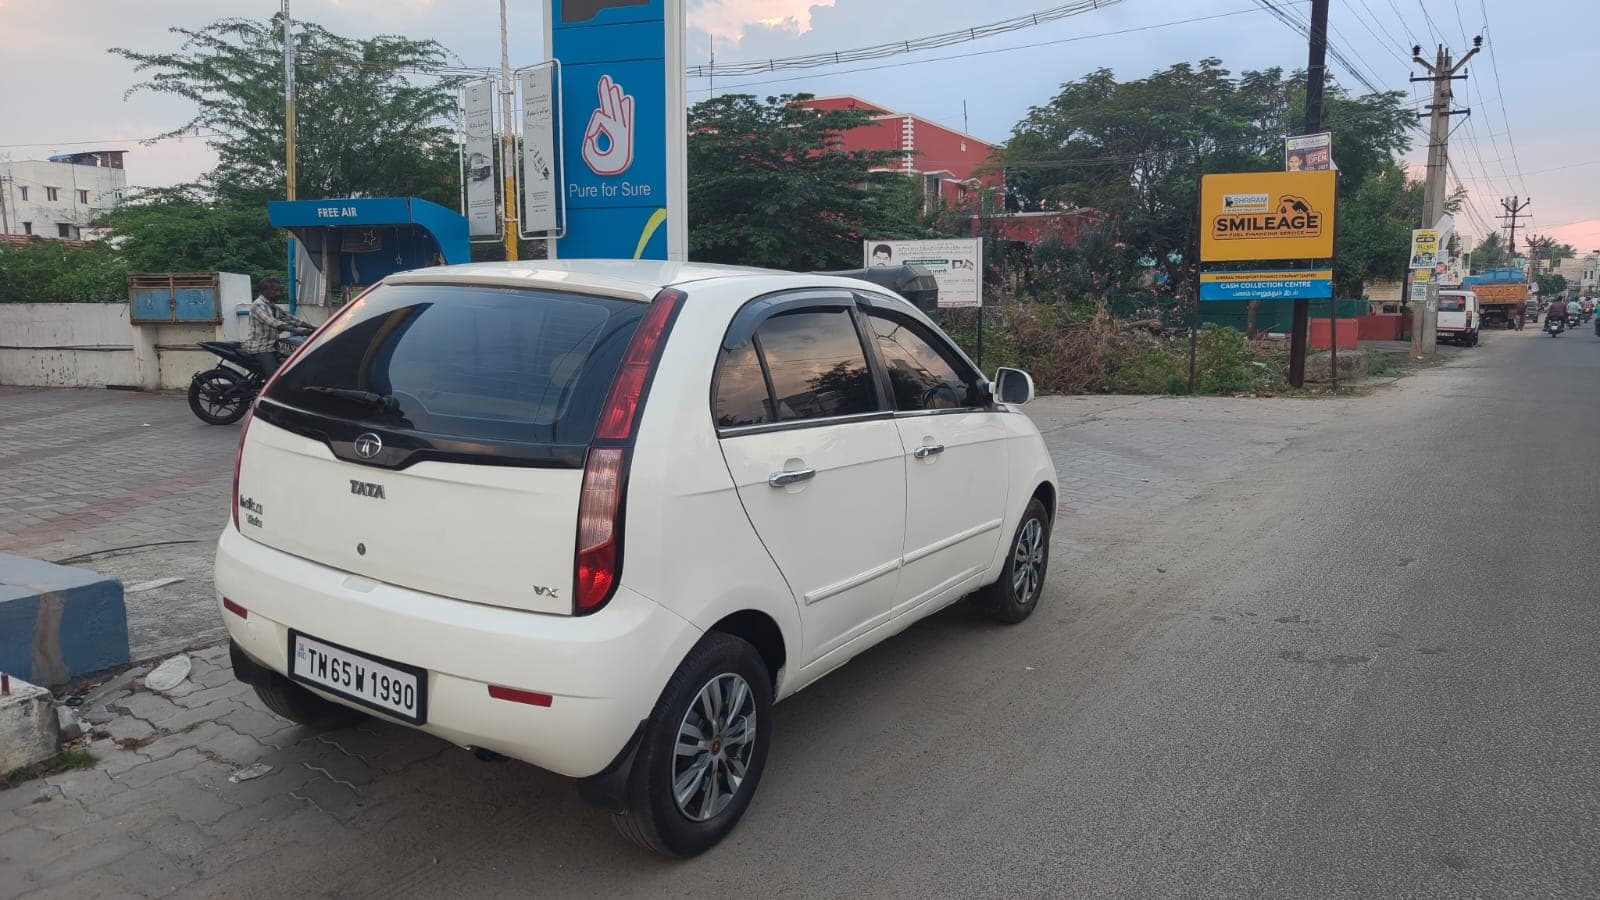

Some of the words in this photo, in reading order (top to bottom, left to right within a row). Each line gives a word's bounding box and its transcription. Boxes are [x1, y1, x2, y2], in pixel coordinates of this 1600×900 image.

[570, 183, 598, 198] Pure
[601, 182, 617, 197] for
[621, 181, 651, 196] Sure
[1234, 196, 1267, 205] SHRIRAM
[318, 208, 339, 218] FREE
[341, 207, 358, 217] AIR
[1216, 214, 1318, 232] SMILEAGE
[1241, 281, 1283, 289] COLLECTION
[350, 480, 386, 500] TATA
[533, 584, 559, 599] VX
